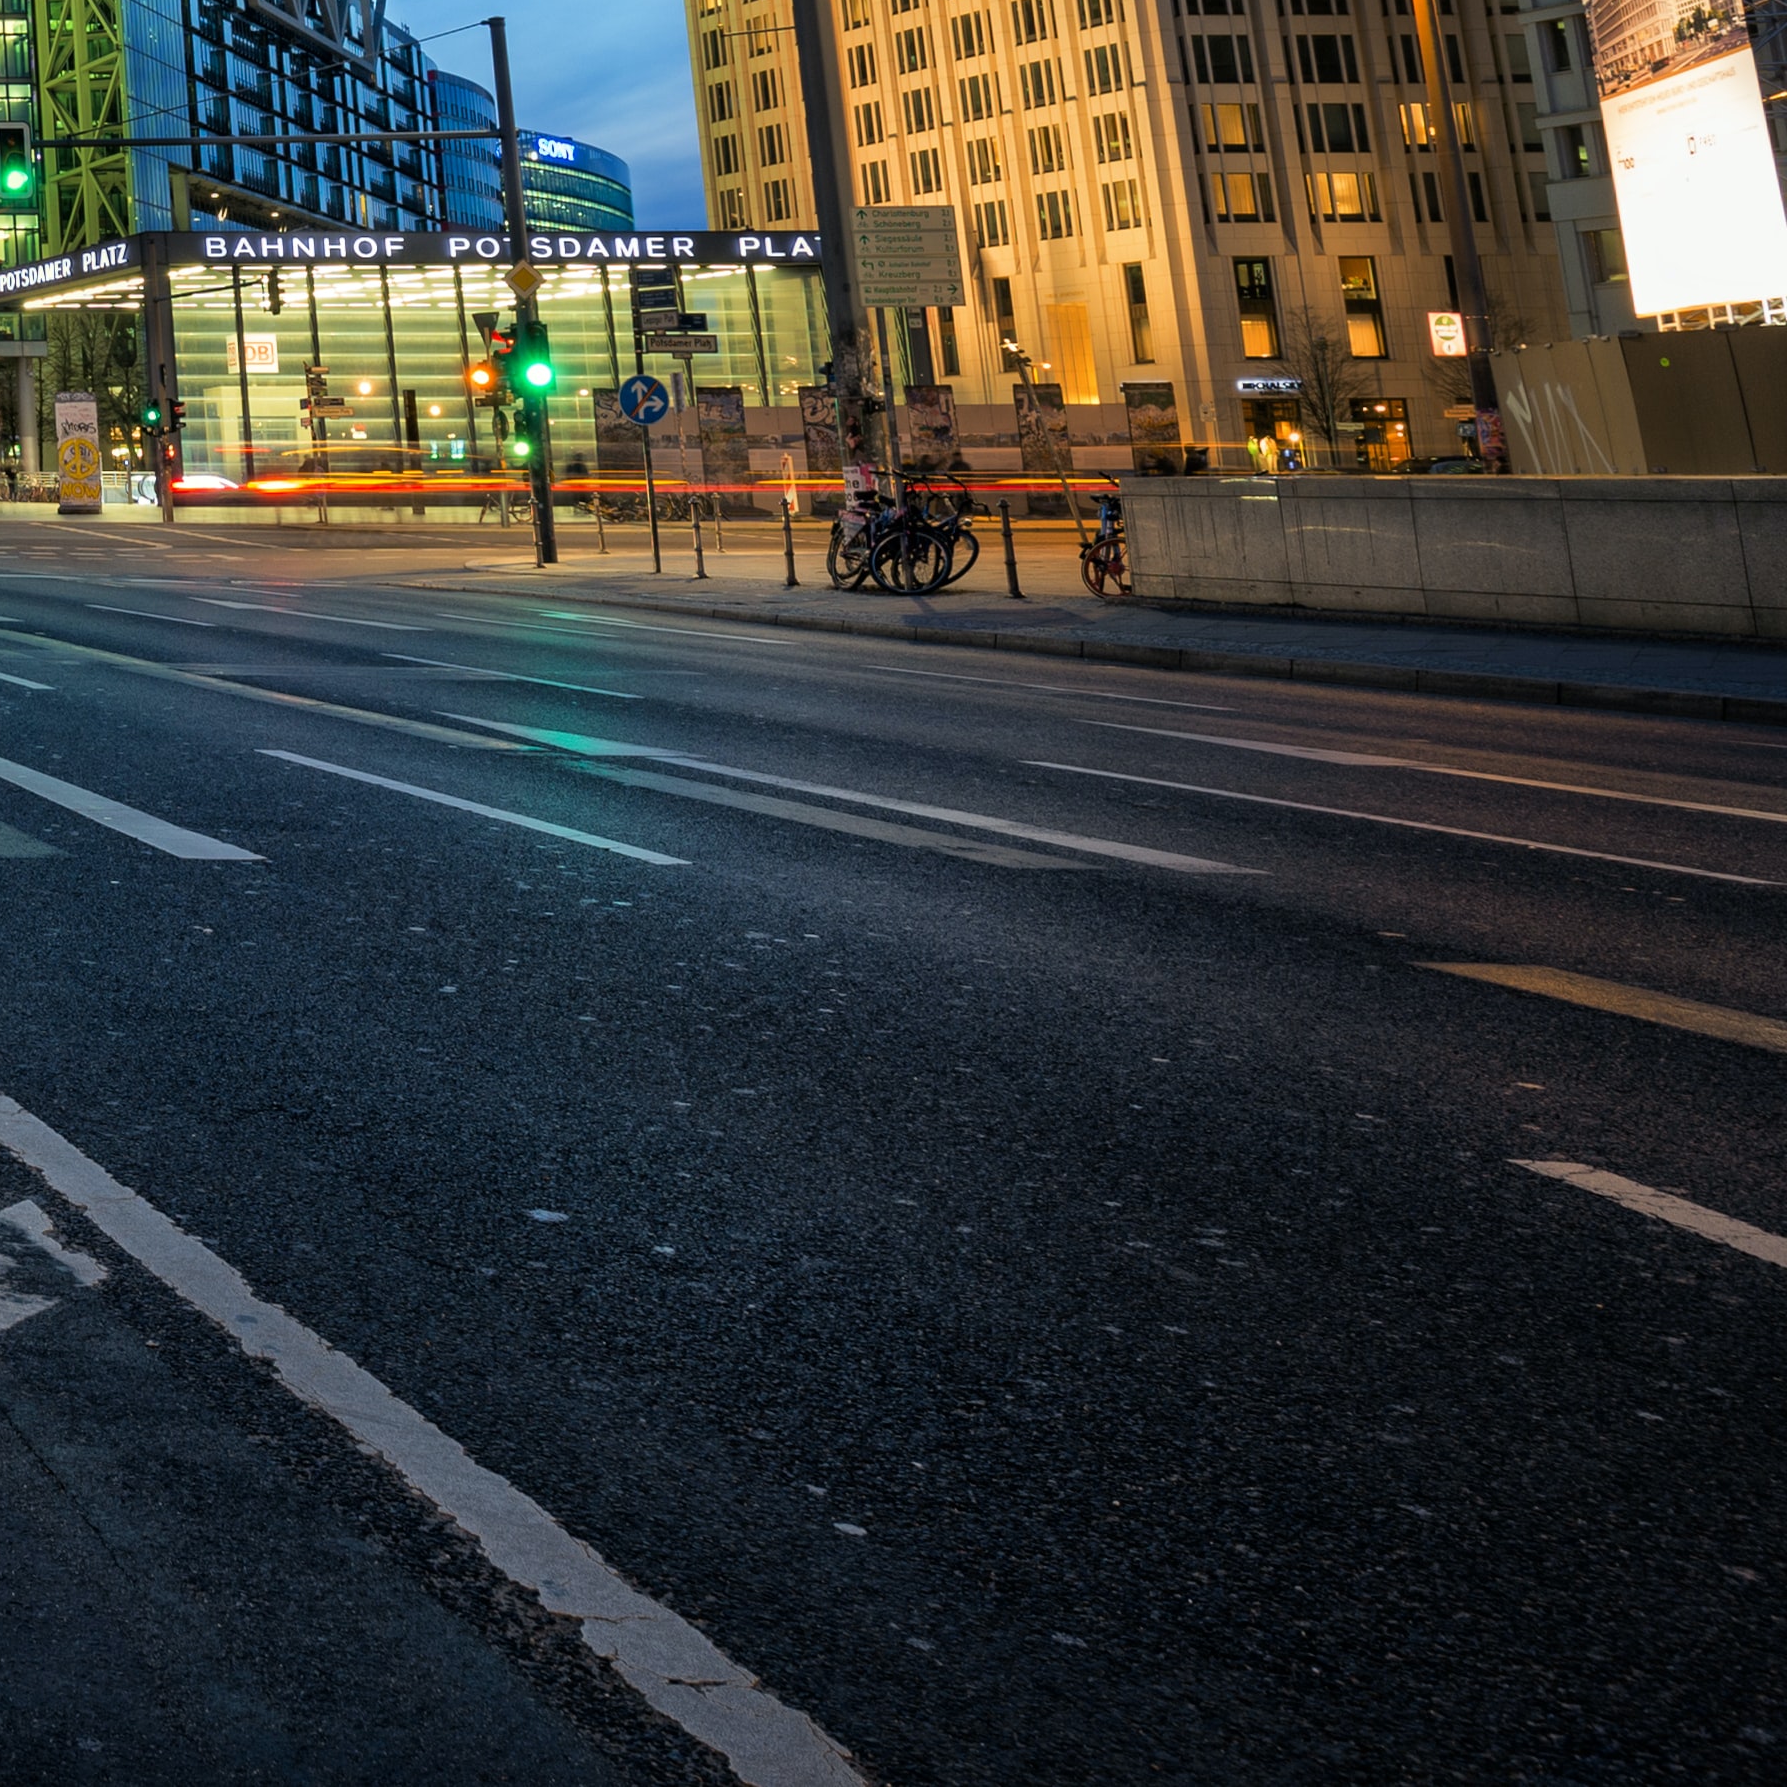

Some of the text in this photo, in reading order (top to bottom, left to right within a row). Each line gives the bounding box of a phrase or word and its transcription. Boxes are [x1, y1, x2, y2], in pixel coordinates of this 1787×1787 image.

[538, 138, 575, 161] SONY
[205, 237, 404, 259] BAHNHOF
[739, 236, 823, 258] PLA
[0, 258, 72, 292] POTSDAMER
[82, 243, 128, 272] PLATZ
[650, 338, 692, 348] Potsdamer
[245, 346, 269, 361] DB
[61, 483, 101, 500] NOW
